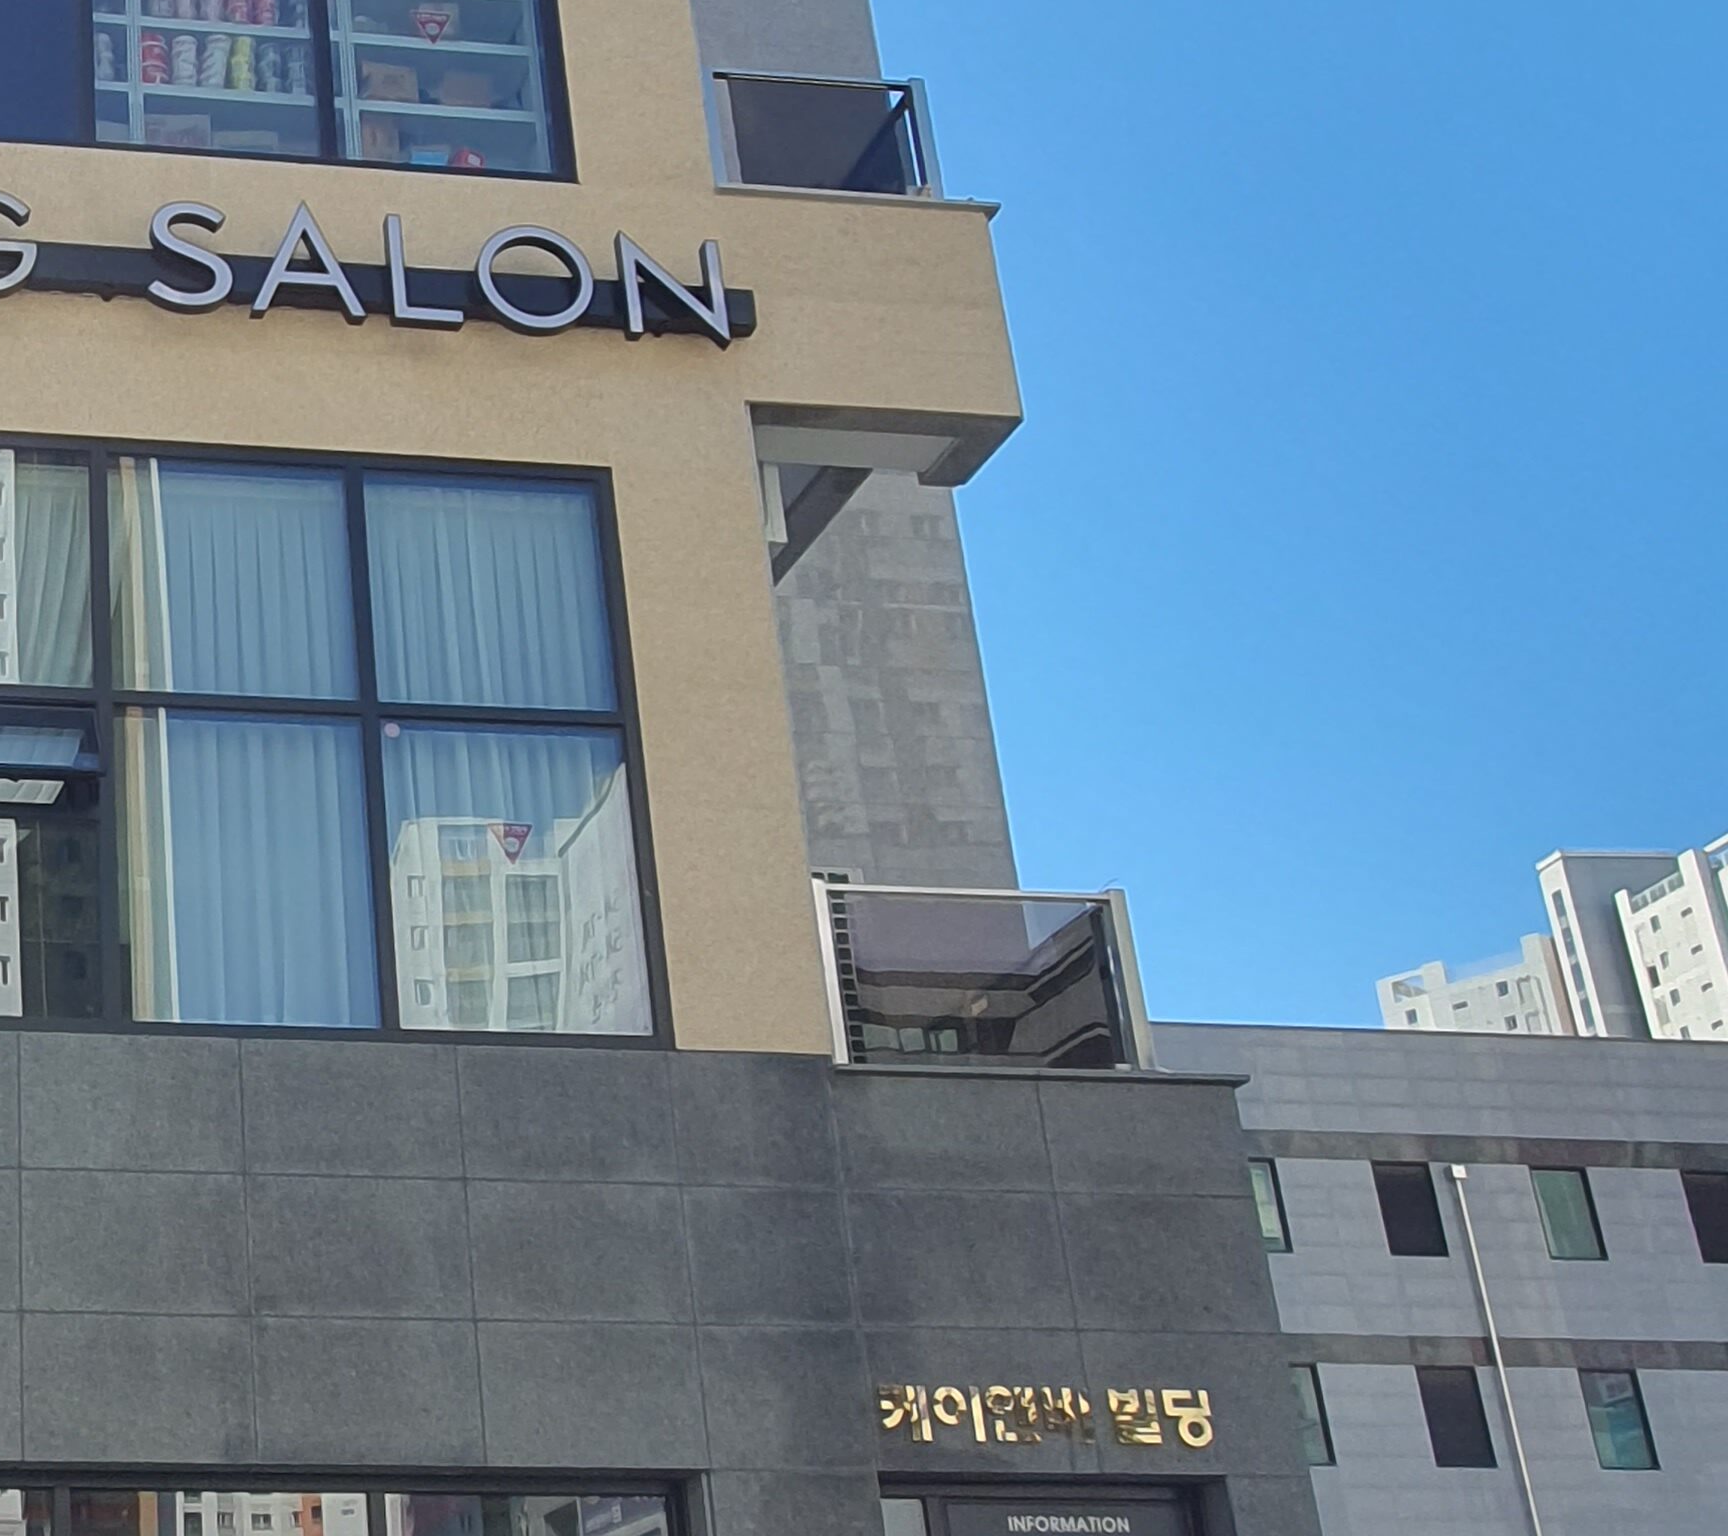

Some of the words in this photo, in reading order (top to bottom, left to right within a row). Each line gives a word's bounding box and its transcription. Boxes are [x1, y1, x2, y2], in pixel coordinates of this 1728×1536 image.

[147, 199, 737, 351] SALON
[1108, 1388, 1214, 1448] 빌딩
[1007, 1515, 1131, 1534] INFORMATION
